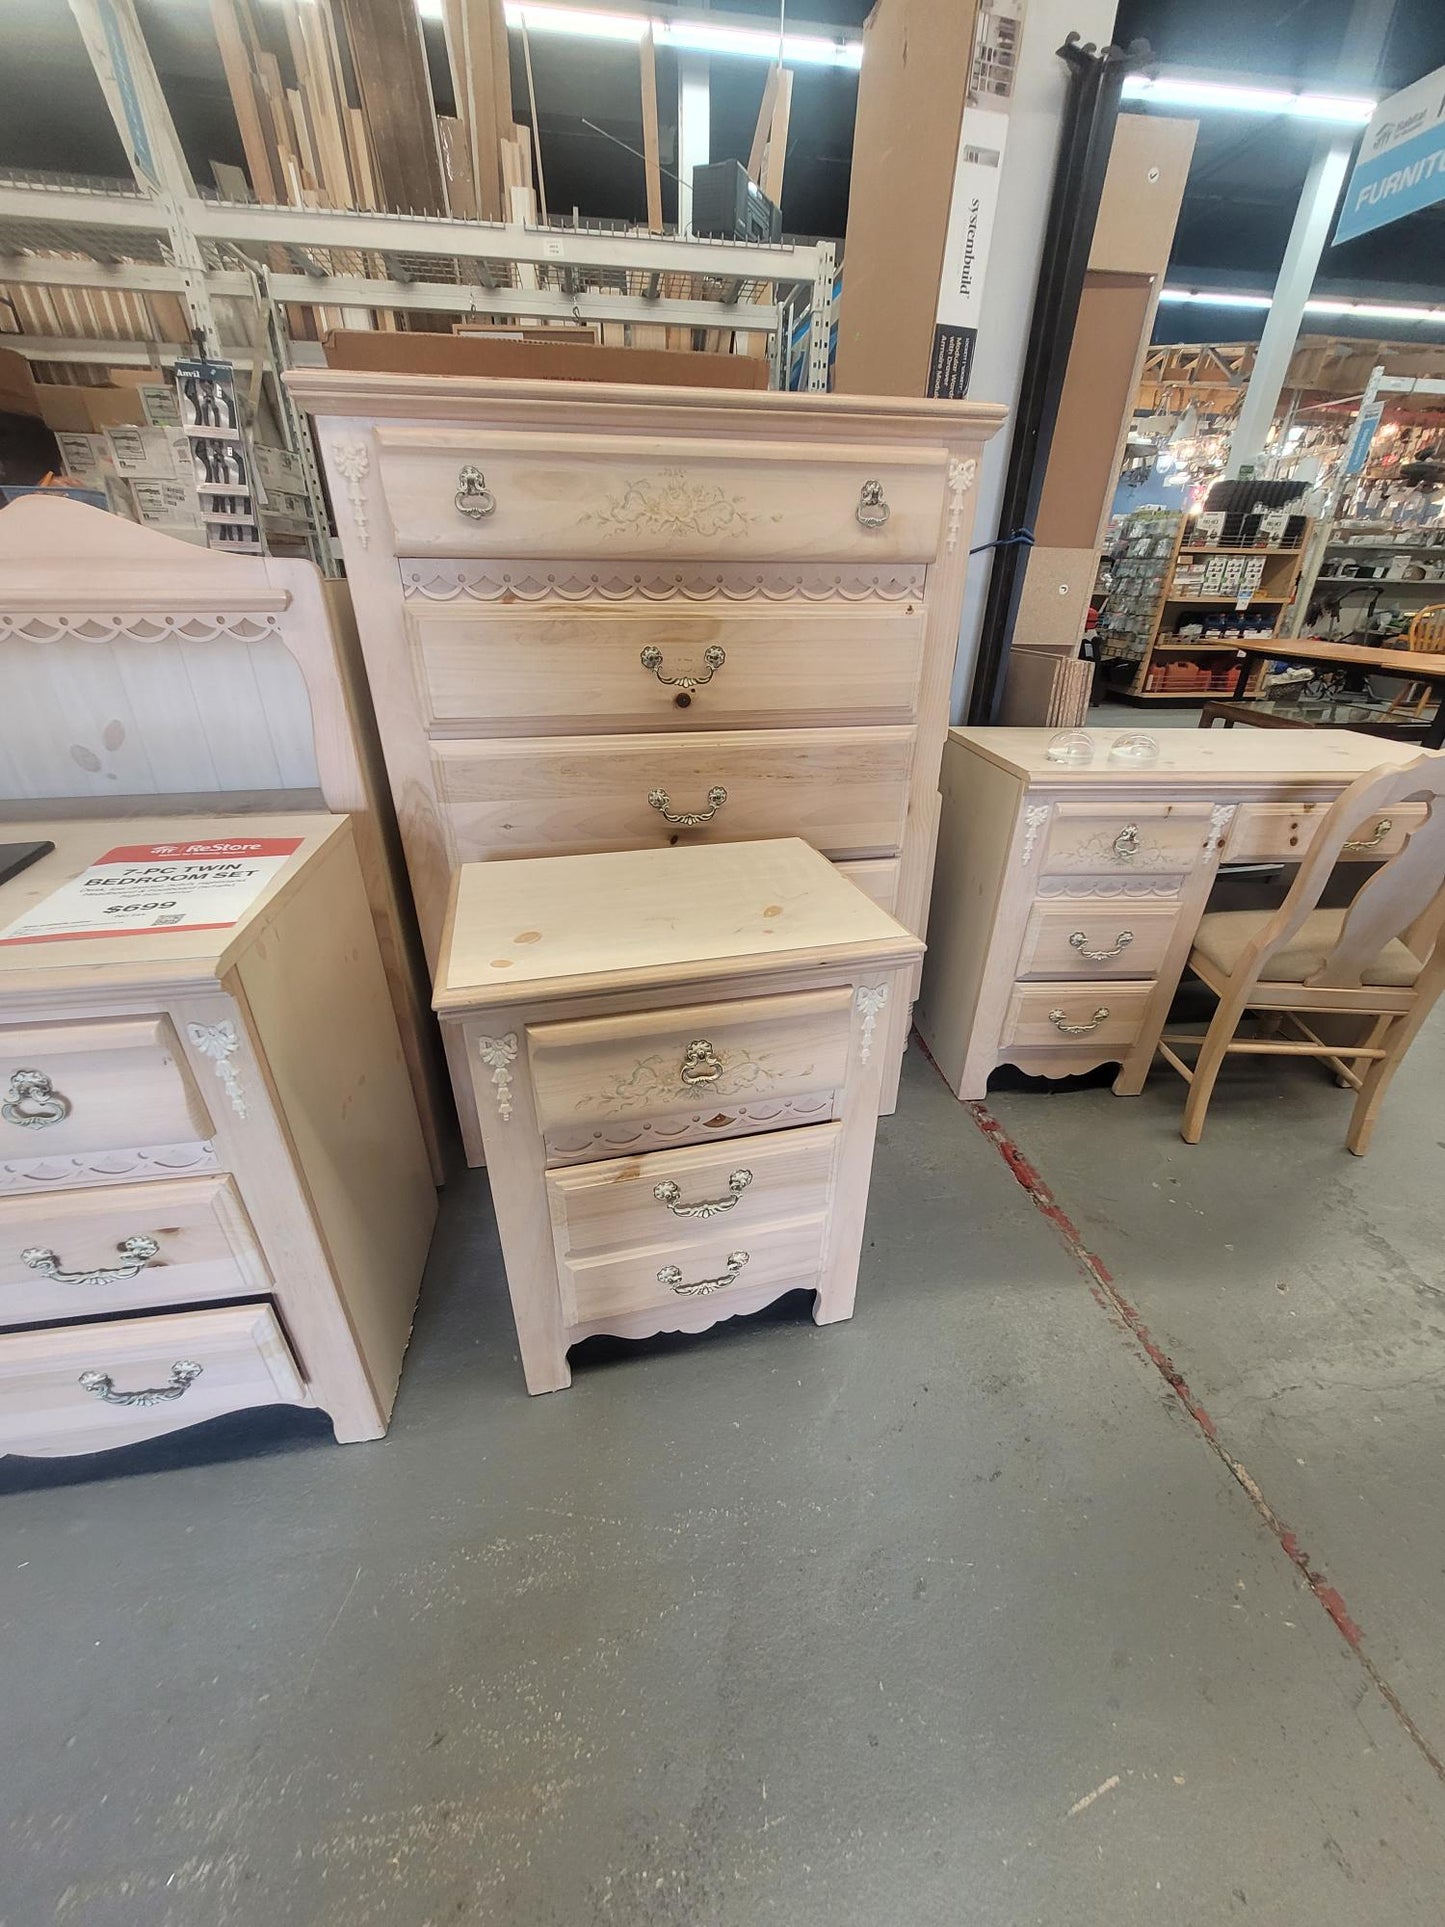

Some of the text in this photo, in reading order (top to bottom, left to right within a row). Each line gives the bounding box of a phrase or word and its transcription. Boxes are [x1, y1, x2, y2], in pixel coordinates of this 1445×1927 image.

[960, 197, 980, 295] systembuild
[937, 335, 947, 370] Armoire
[953, 336, 962, 372] Modular
[944, 356, 953, 387] Drawer
[185, 843, 262, 853] ReStore
[84, 873, 208, 886] BEDROOM
[212, 869, 260, 879] SET
[123, 863, 242, 876] 7-PC TWIN
[102, 900, 177, 914] $699
